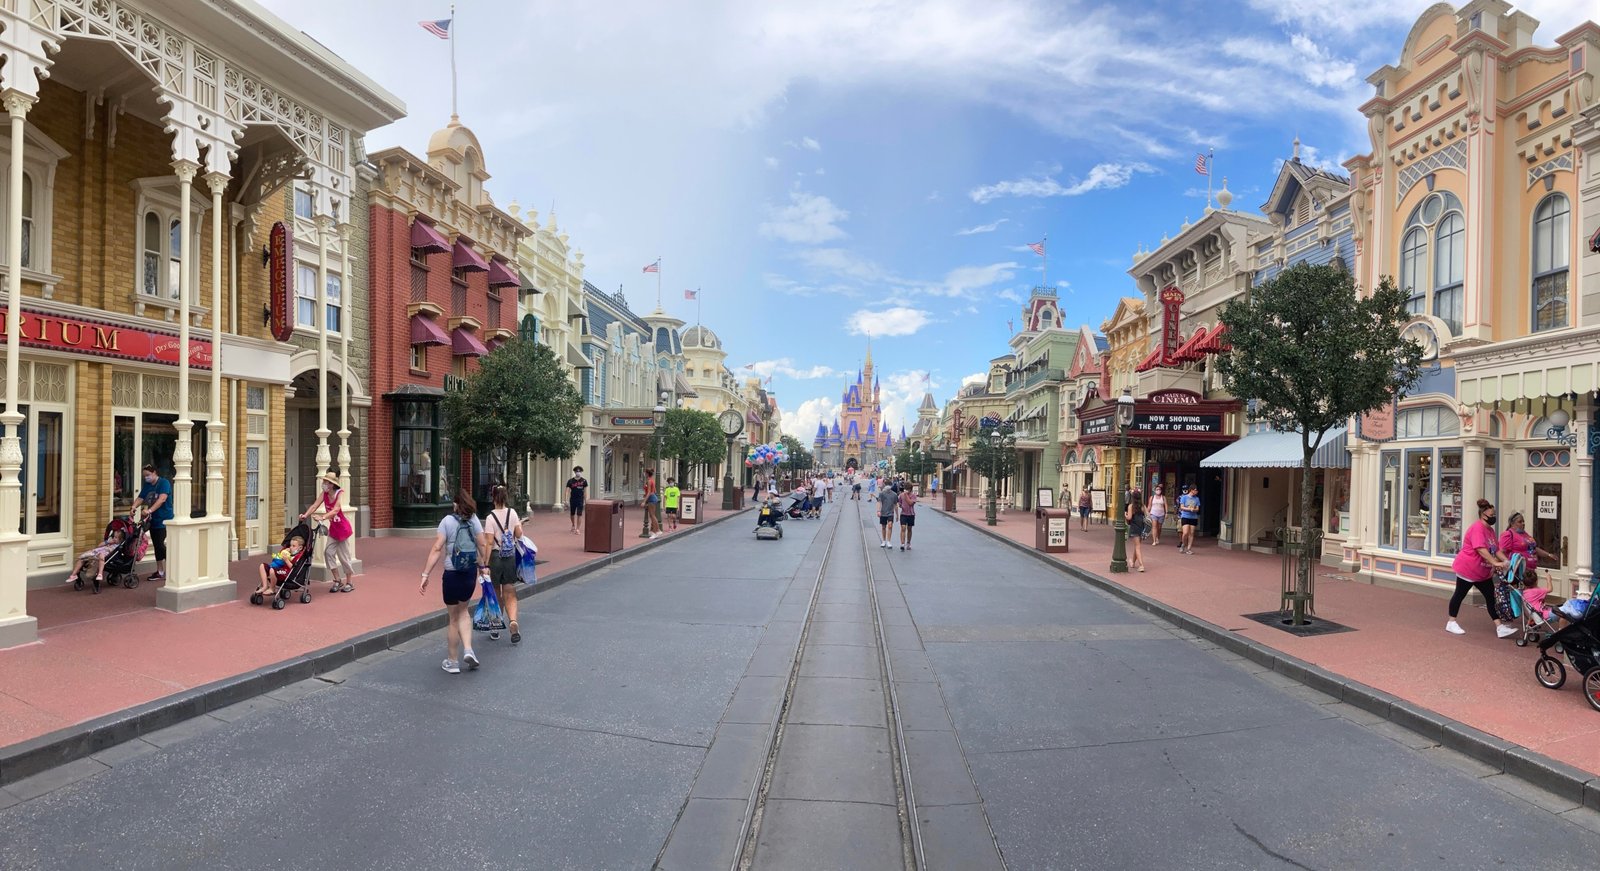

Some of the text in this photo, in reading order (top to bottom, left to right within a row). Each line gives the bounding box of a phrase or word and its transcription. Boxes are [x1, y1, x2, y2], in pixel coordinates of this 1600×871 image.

[274, 235, 285, 328] EMPORIUM
[1168, 303, 1178, 356] CINEMA
[155, 343, 167, 354] Dry
[1153, 395, 1197, 404] CINEMA
